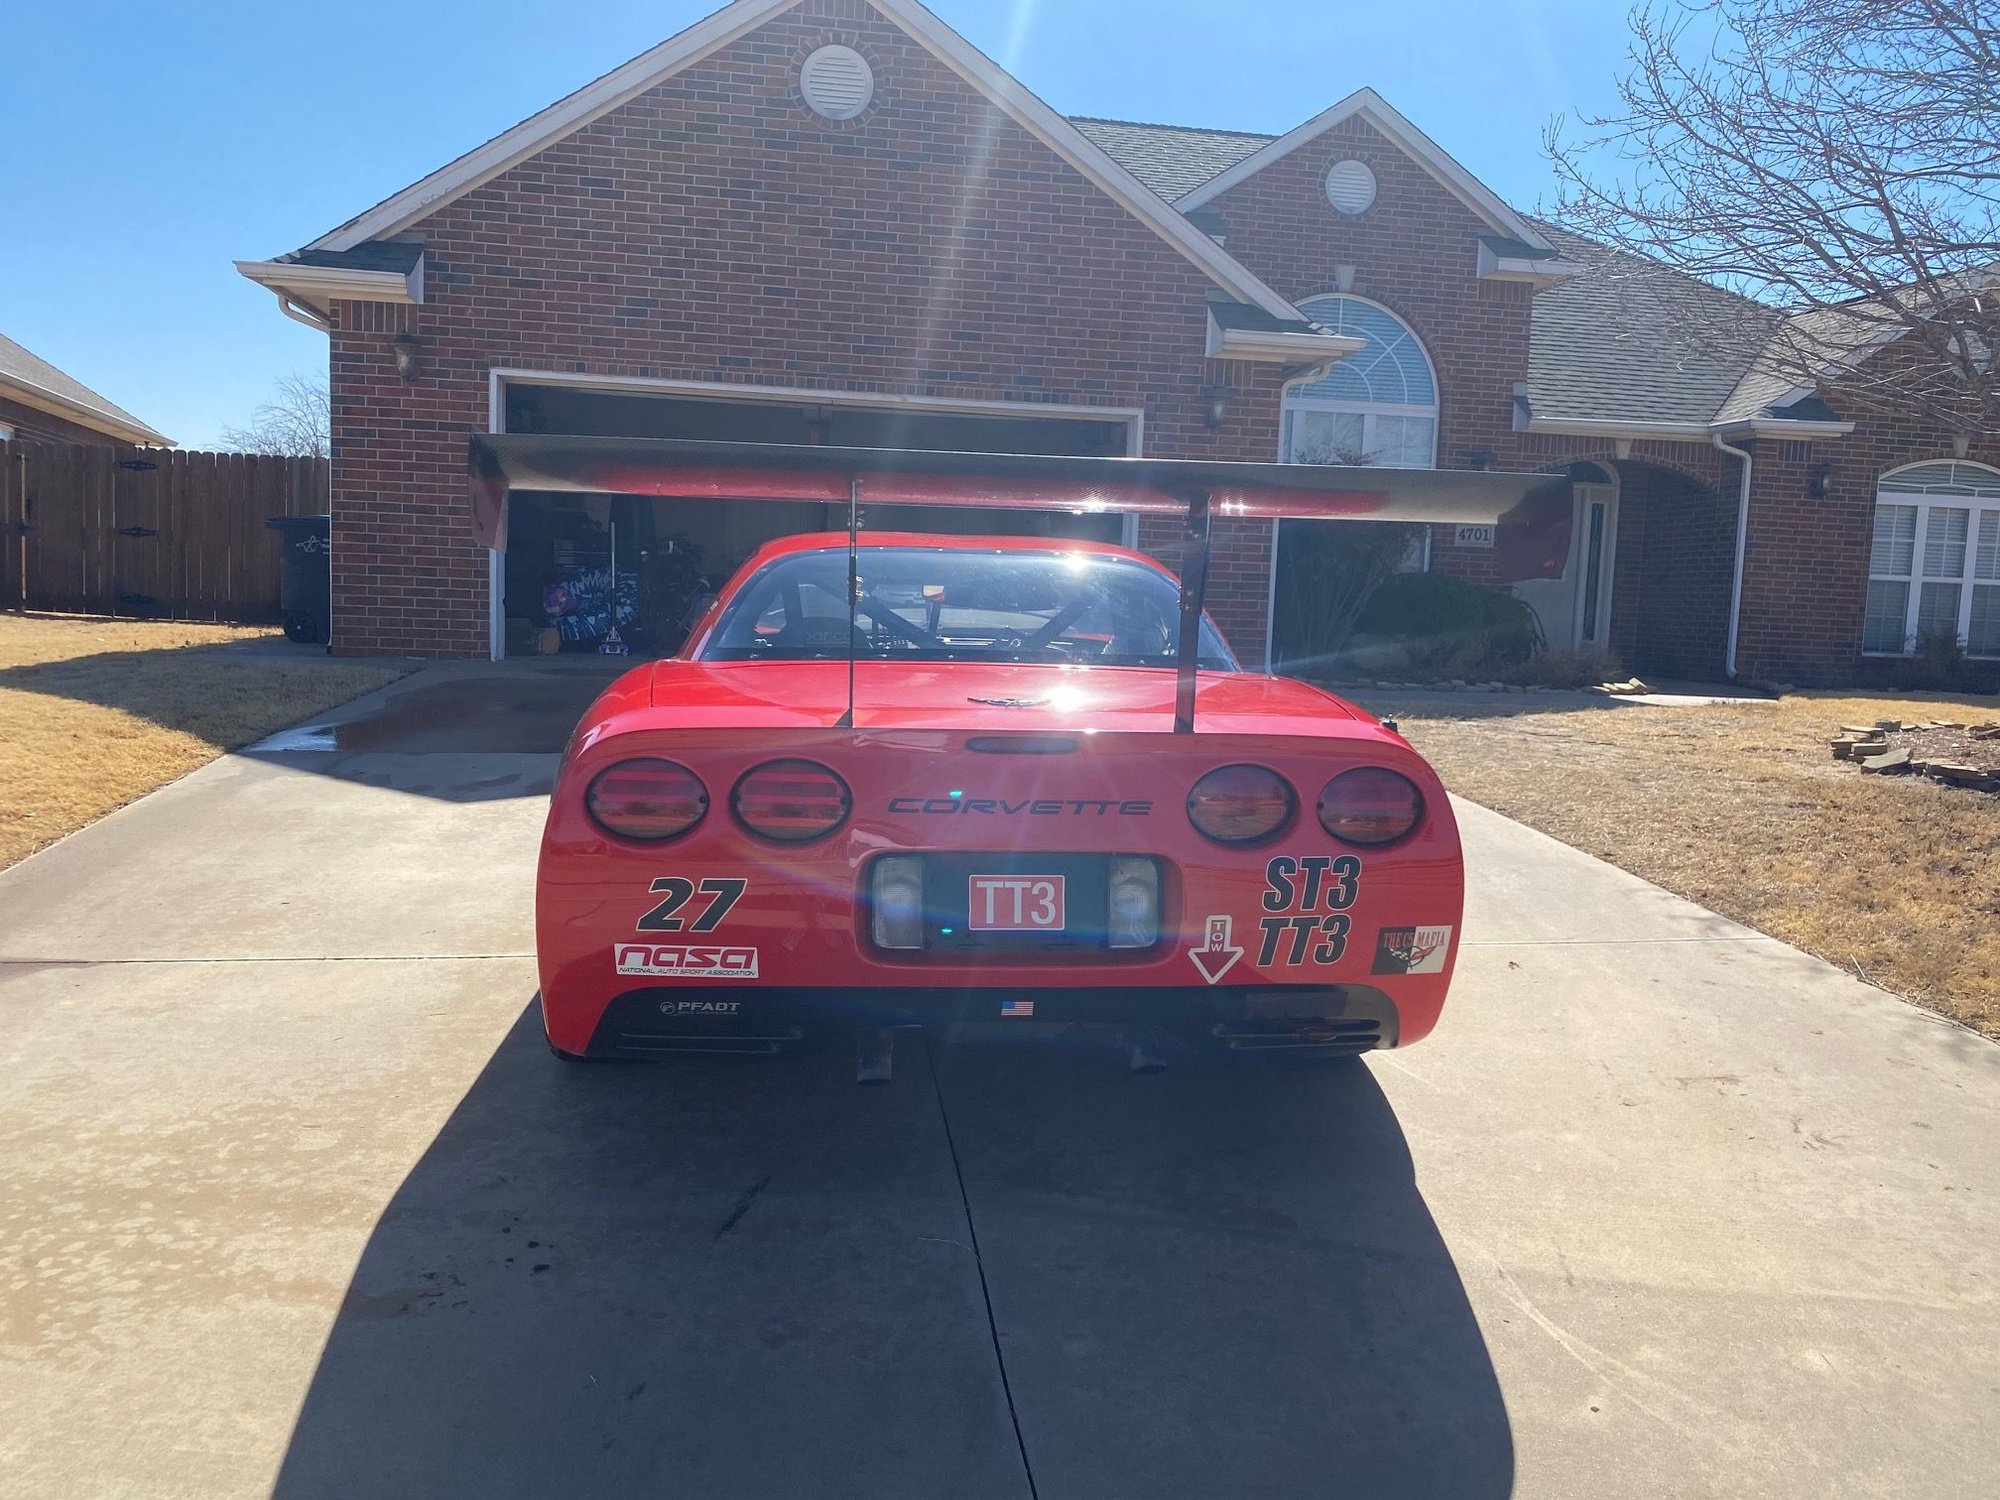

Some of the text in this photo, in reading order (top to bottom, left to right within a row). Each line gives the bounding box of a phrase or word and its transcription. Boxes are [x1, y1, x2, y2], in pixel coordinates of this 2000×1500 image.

[1459, 527, 1489, 541] 4701
[888, 797, 1153, 816] CORVETTE
[1262, 854, 1362, 912] ST3
[636, 876, 748, 932] 27
[976, 881, 1056, 924] TT3
[1210, 921, 1225, 952] TOW
[1256, 913, 1352, 967] TT3
[1383, 930, 1445, 948] THE C5 MAFIA
[678, 1002, 741, 1011] PFADT
